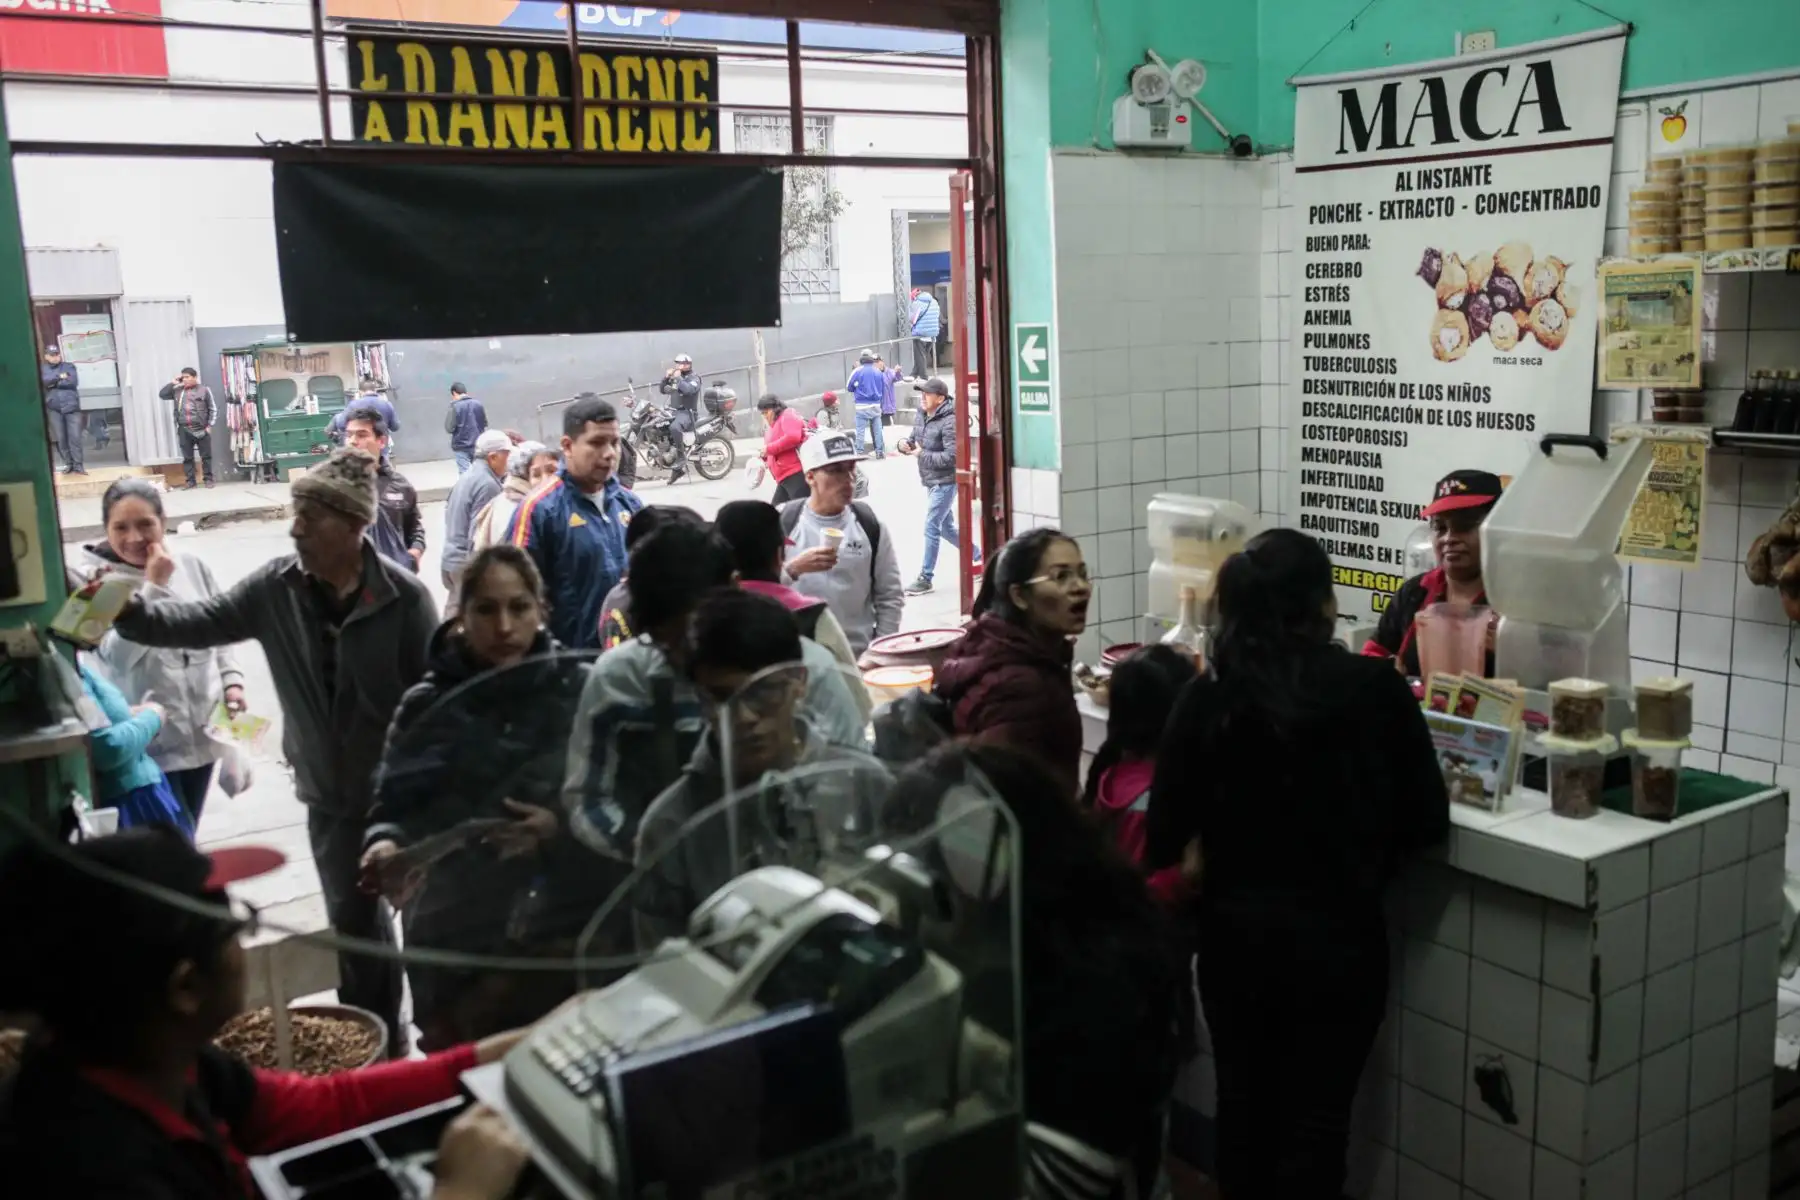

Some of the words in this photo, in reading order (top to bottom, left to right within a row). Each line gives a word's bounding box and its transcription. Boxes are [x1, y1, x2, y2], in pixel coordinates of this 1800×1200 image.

[397, 42, 571, 151] RANA
[578, 53, 711, 153] RENE
[1335, 59, 1571, 155] MACA
[1395, 172, 1413, 192] AL
[1417, 164, 1492, 190] INSTANTE
[1309, 202, 1363, 225] PONCHE
[1379, 196, 1455, 221] EXTRACTO
[1475, 185, 1601, 215] CONCENTRADO
[1306, 236, 1339, 252] BUENO
[1341, 233, 1371, 251] PARA:
[1305, 262, 1363, 279] CEREBRO
[1305, 283, 1350, 302] ESTRÉS
[1304, 309, 1352, 326] ANEMIA
[1304, 333, 1371, 350] PULMONES
[1303, 356, 1397, 375] TUBERCULOSIS
[1493, 356, 1517, 366] maca
[1520, 356, 1543, 366] seca
[1021, 391, 1048, 405] SALIDA
[1303, 378, 1396, 399] DESNUTRICIÓN
[1400, 383, 1415, 400] DE
[1419, 384, 1443, 401] LOS
[1447, 381, 1491, 404] NIÑOS
[1302, 401, 1423, 425] DESCALCIFICACIÓN
[1427, 409, 1443, 426] DE
[1447, 410, 1472, 428] LOS
[1476, 411, 1535, 431] HUESOS
[1301, 447, 1382, 469] MENOPAUSIA
[1301, 469, 1384, 492] INFERTILIDAD
[1301, 491, 1378, 515] IMPOTENCIA
[1300, 513, 1380, 538] RAQUITISMO
[1317, 537, 1374, 560] OBLEMAS
[1377, 546, 1392, 564] EN
